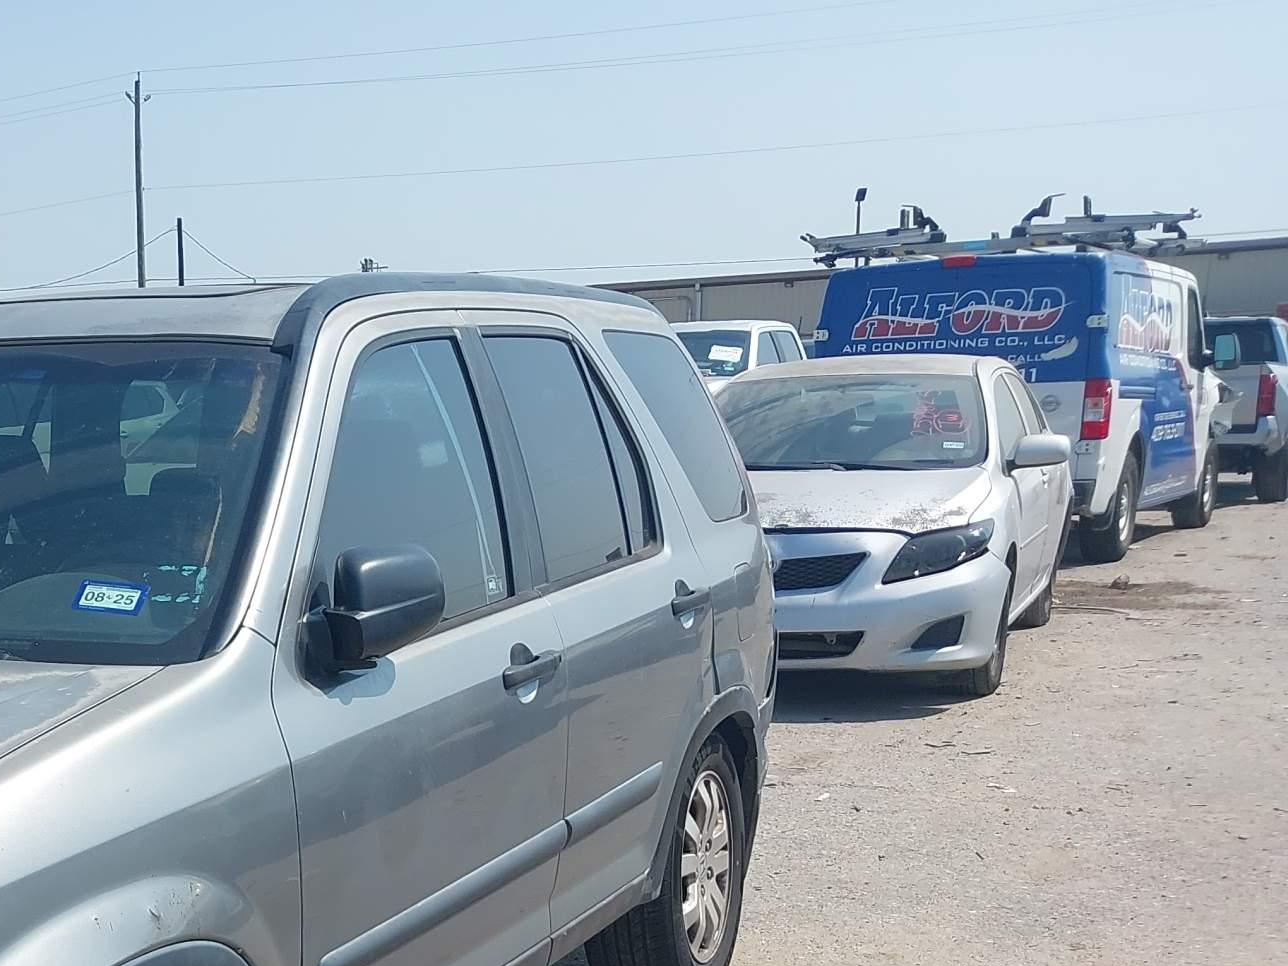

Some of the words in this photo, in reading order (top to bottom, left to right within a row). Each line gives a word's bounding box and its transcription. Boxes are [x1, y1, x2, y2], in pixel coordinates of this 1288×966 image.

[851, 287, 1067, 341] ALFORD
[842, 342, 867, 354] AIR
[871, 337, 989, 351] CONDITIONING
[995, 336, 1028, 347] CO.,
[1034, 334, 1066, 345] LLC
[1007, 354, 1042, 362] CALL
[84, 591, 106, 603] 08
[112, 593, 136, 606] 25
